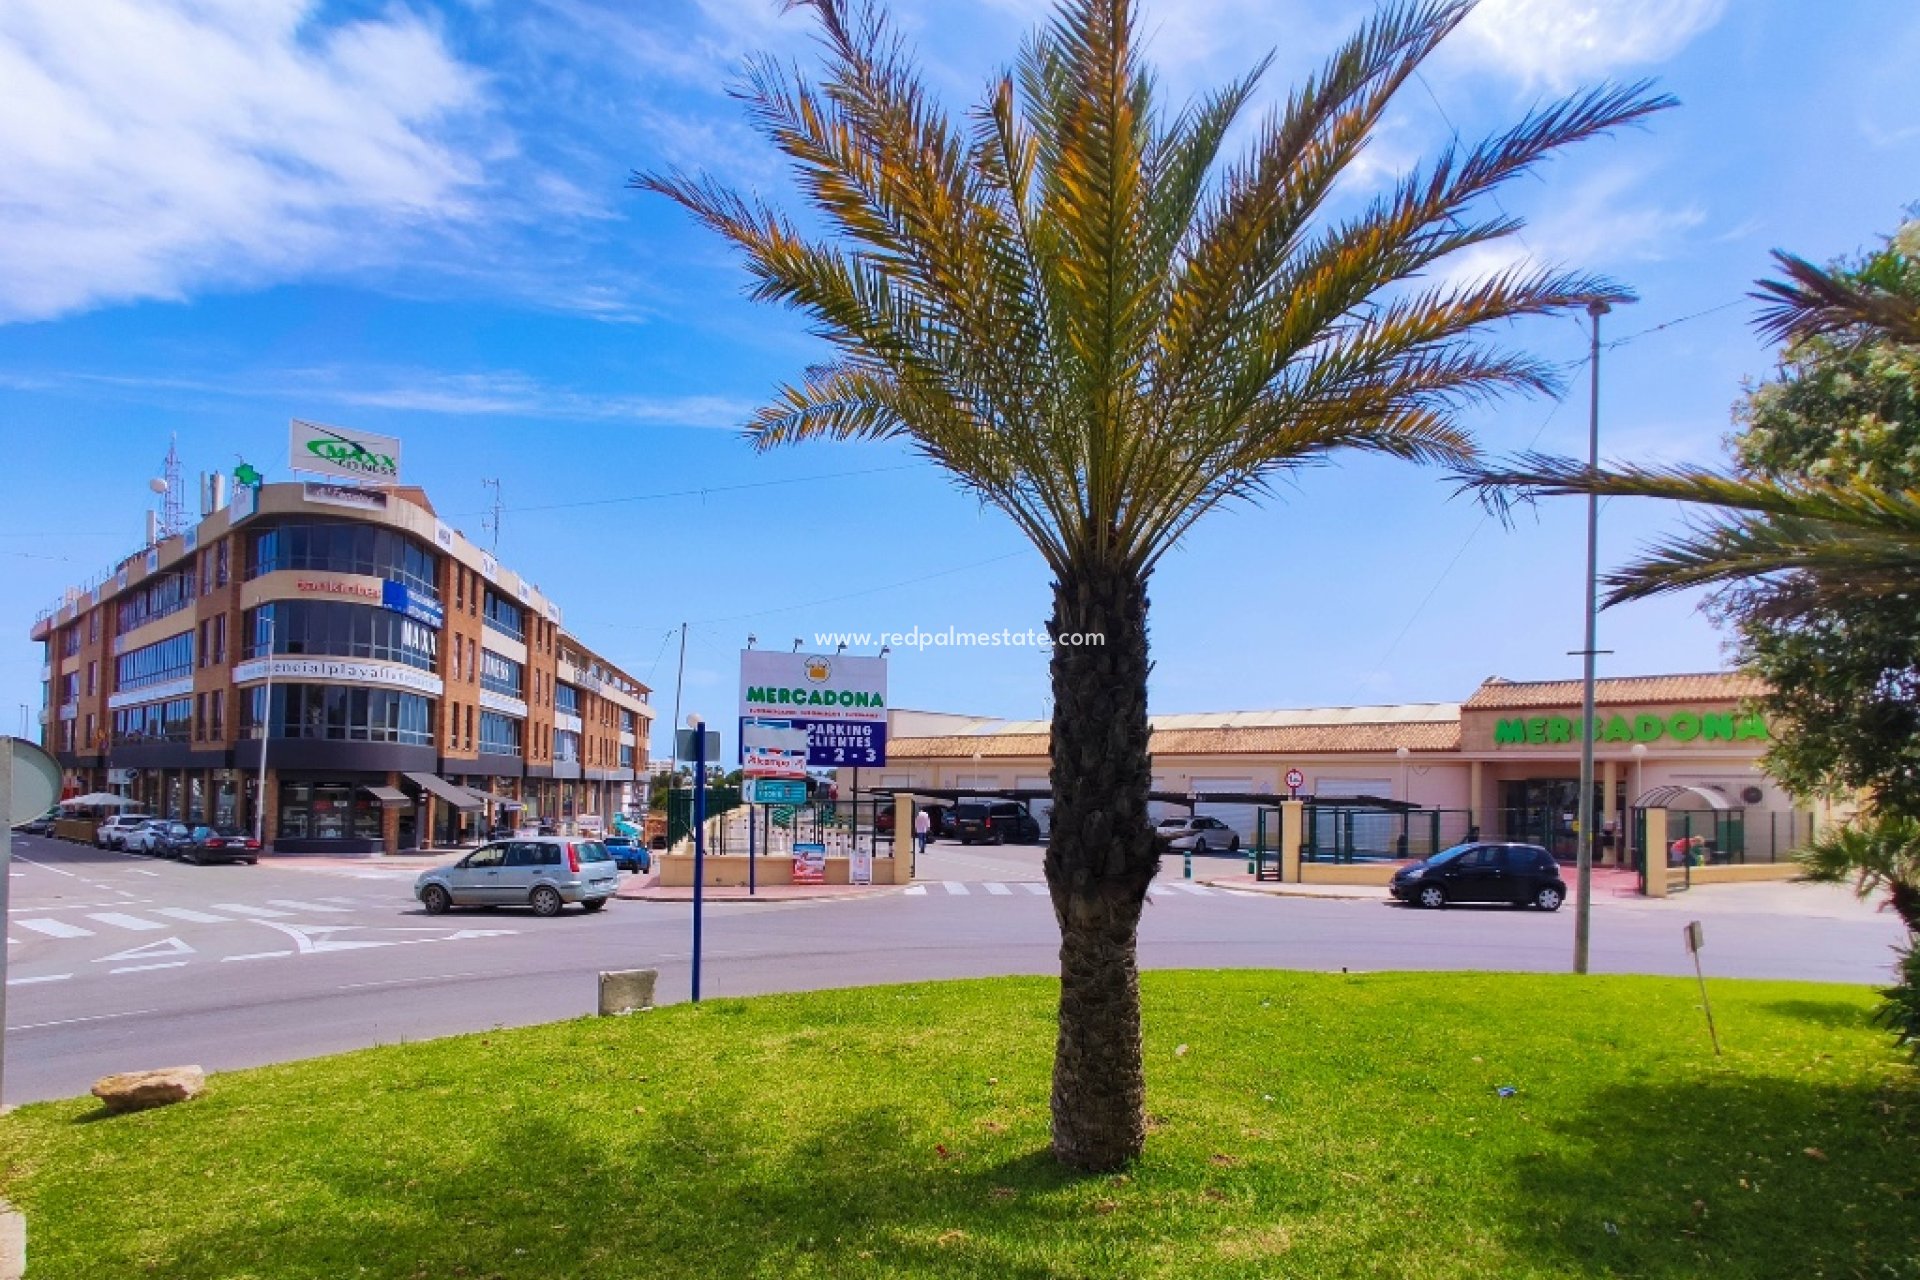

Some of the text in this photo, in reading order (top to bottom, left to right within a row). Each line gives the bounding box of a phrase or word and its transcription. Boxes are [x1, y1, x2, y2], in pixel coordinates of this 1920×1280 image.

[746, 685, 884, 708] MERCADONA
[807, 723, 873, 736] PARKING
[1494, 710, 1769, 744] MERCADONA
[807, 735, 871, 748] CLIENTES
[833, 748, 845, 762] 2
[865, 748, 877, 763] 3
